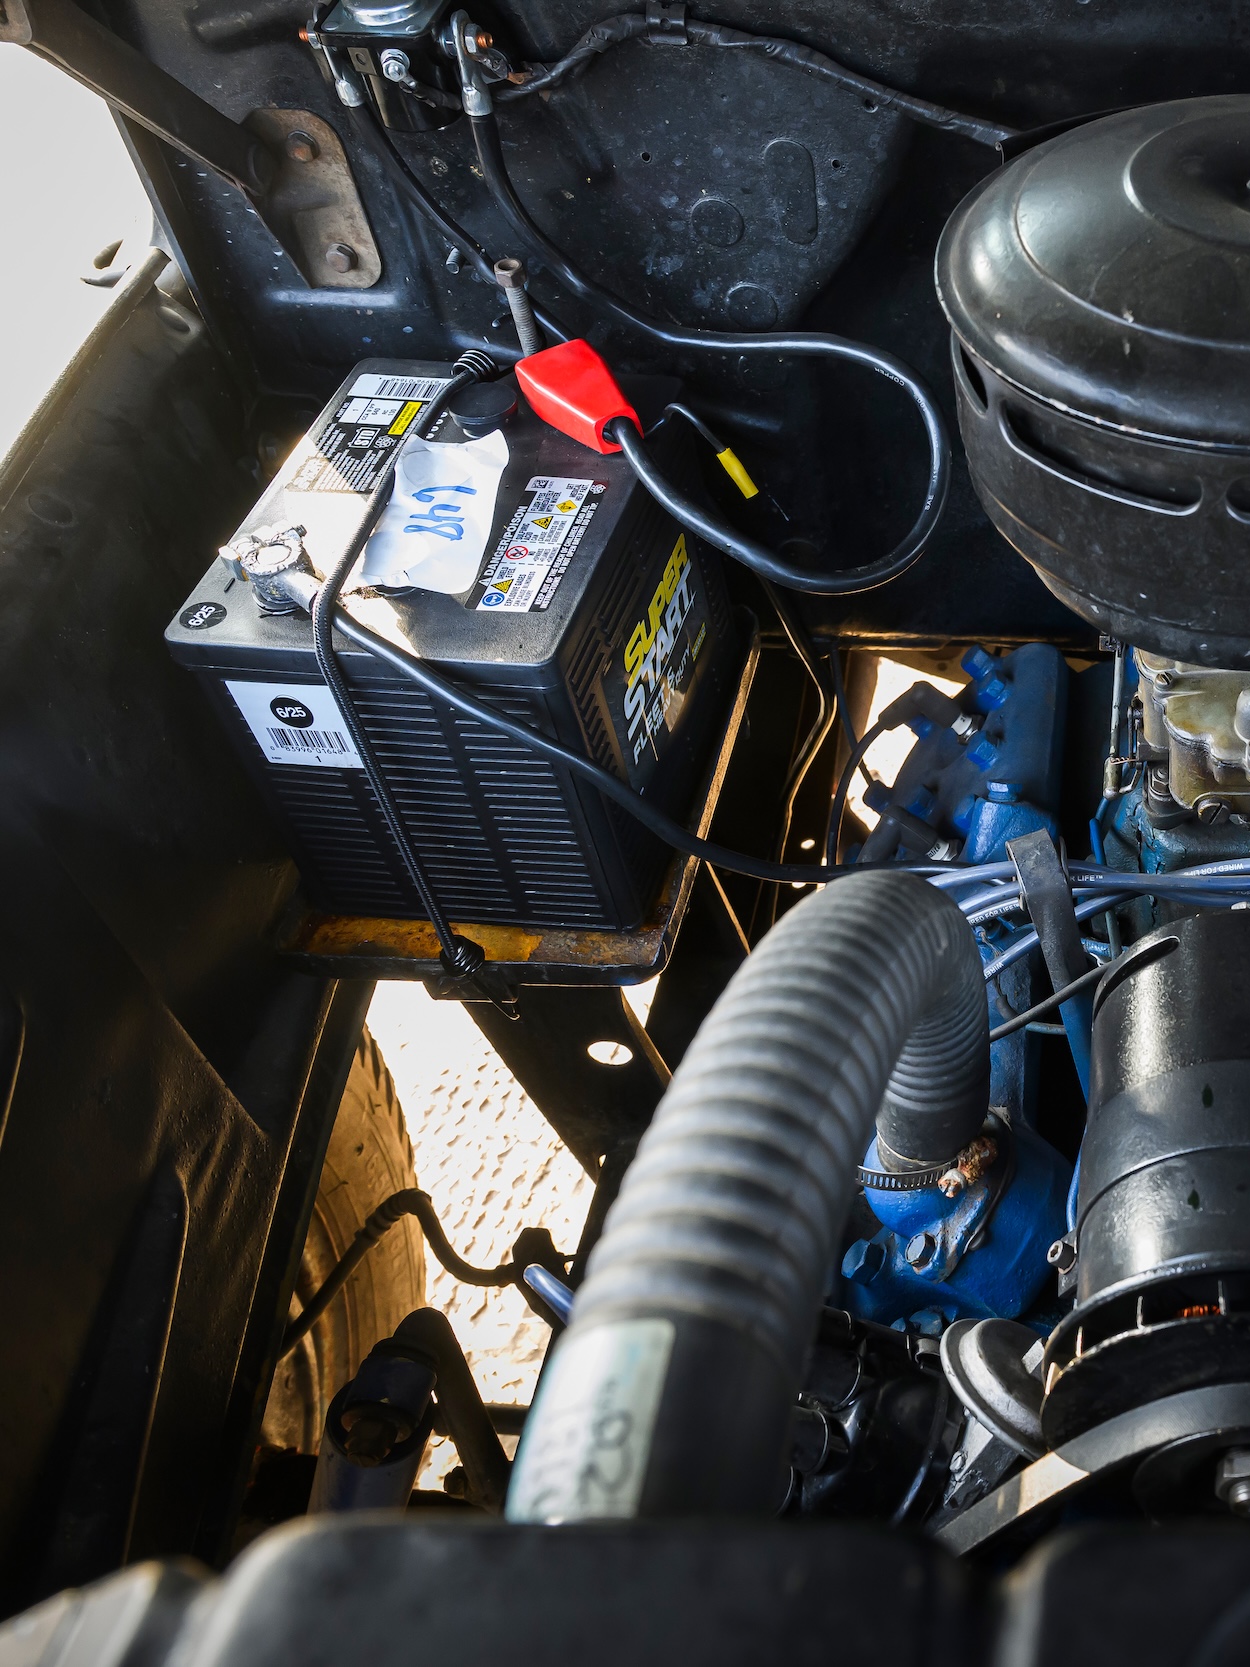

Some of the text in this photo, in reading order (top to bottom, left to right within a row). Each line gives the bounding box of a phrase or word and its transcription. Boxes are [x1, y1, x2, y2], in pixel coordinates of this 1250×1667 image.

[355, 429, 377, 445] STD
[483, 505, 528, 575] DANGER/POISON
[188, 605, 216, 626] 6/25
[624, 533, 689, 687] SUPER
[624, 560, 693, 741] START
[276, 707, 307, 718] 6/25
[633, 683, 666, 764] FLEET
[315, 755, 322, 763] 1
